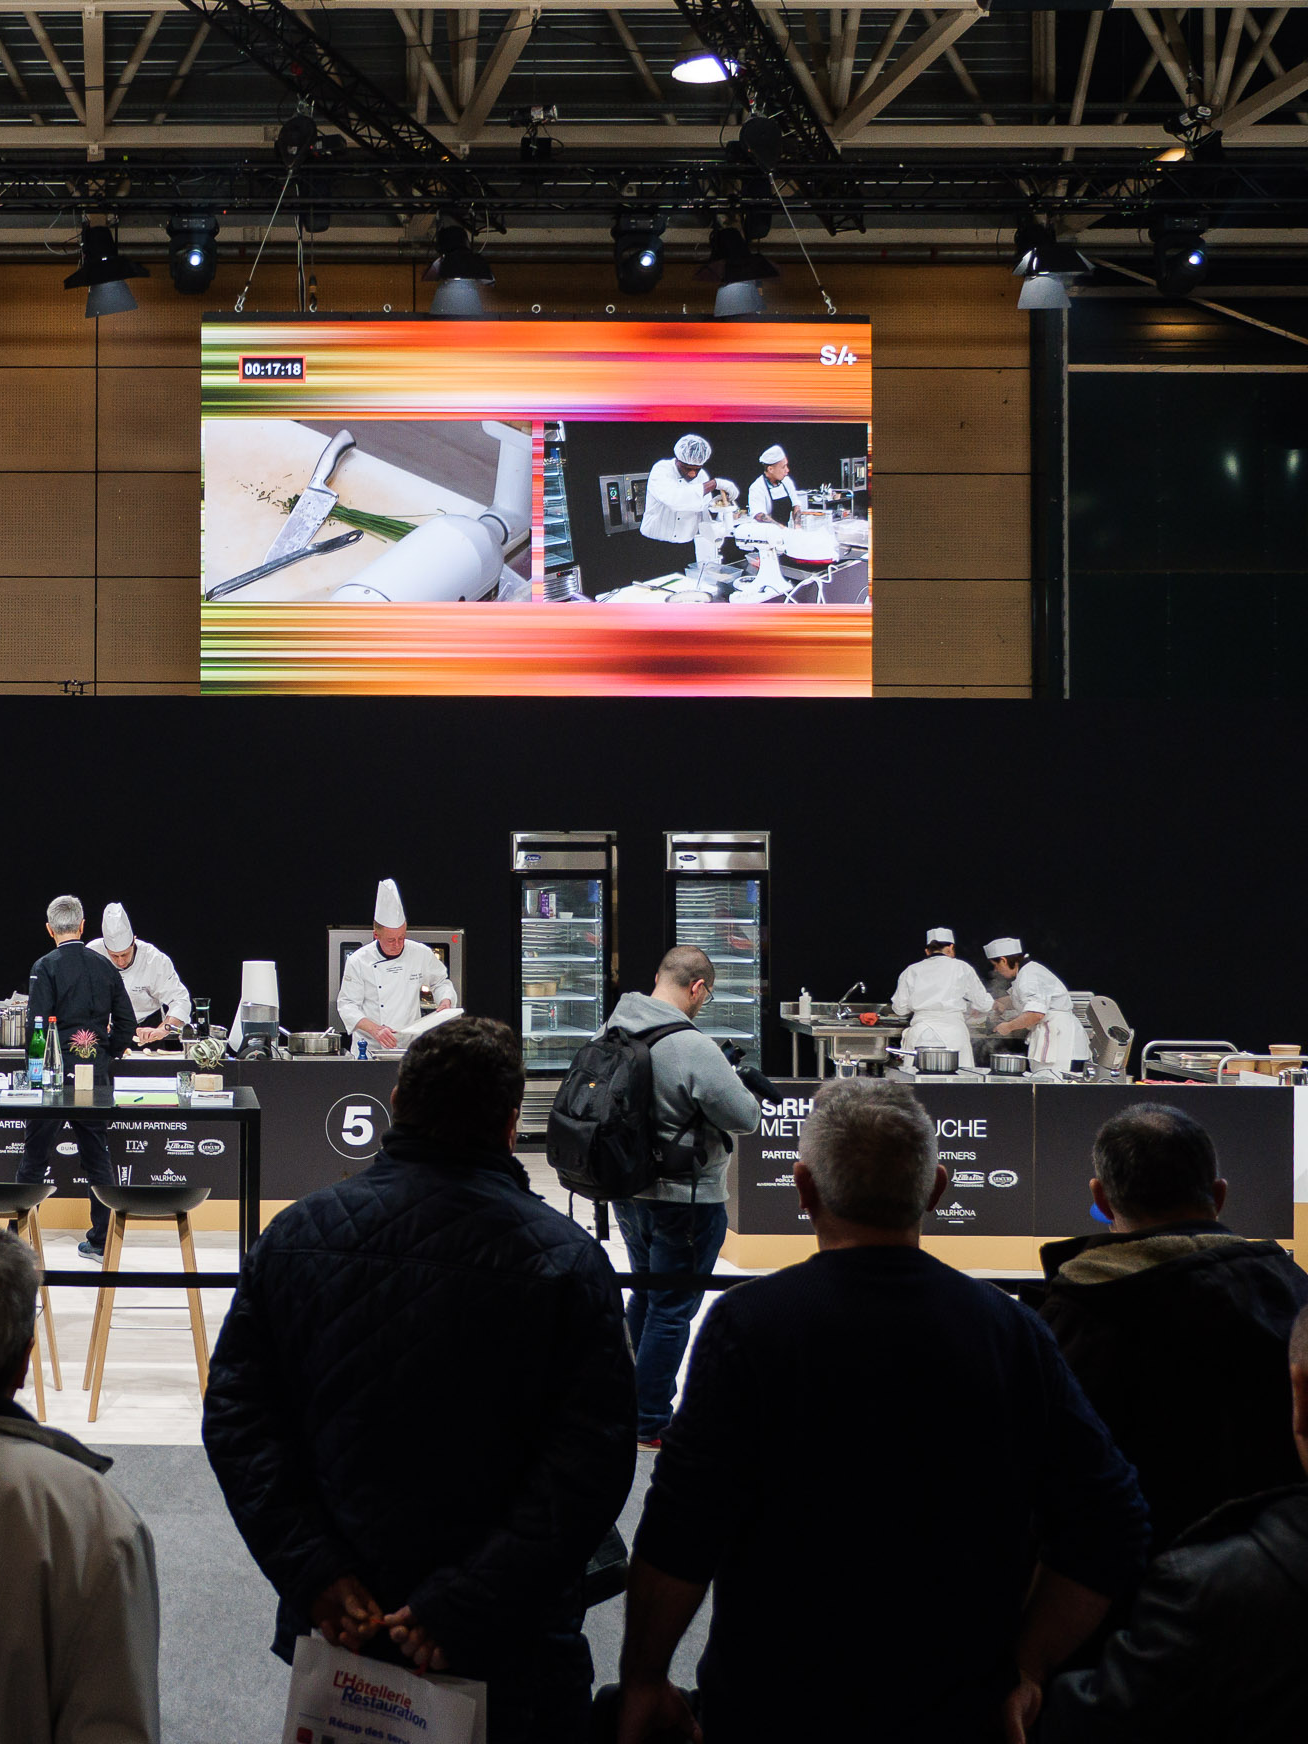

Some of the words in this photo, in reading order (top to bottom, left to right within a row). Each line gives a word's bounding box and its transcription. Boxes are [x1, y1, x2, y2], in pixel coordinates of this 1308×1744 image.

[244, 362, 301, 376] 00:17:18
[143, 1121, 188, 1131] PARTNERS
[341, 1105, 374, 1146] 5
[761, 1150, 802, 1160] PARTEN
[150, 1174, 188, 1182] VALRHONA
[935, 1209, 977, 1217] VALRHONA
[333, 1670, 412, 1708] L'Hôtellerie
[341, 1685, 428, 1730] Restauration
